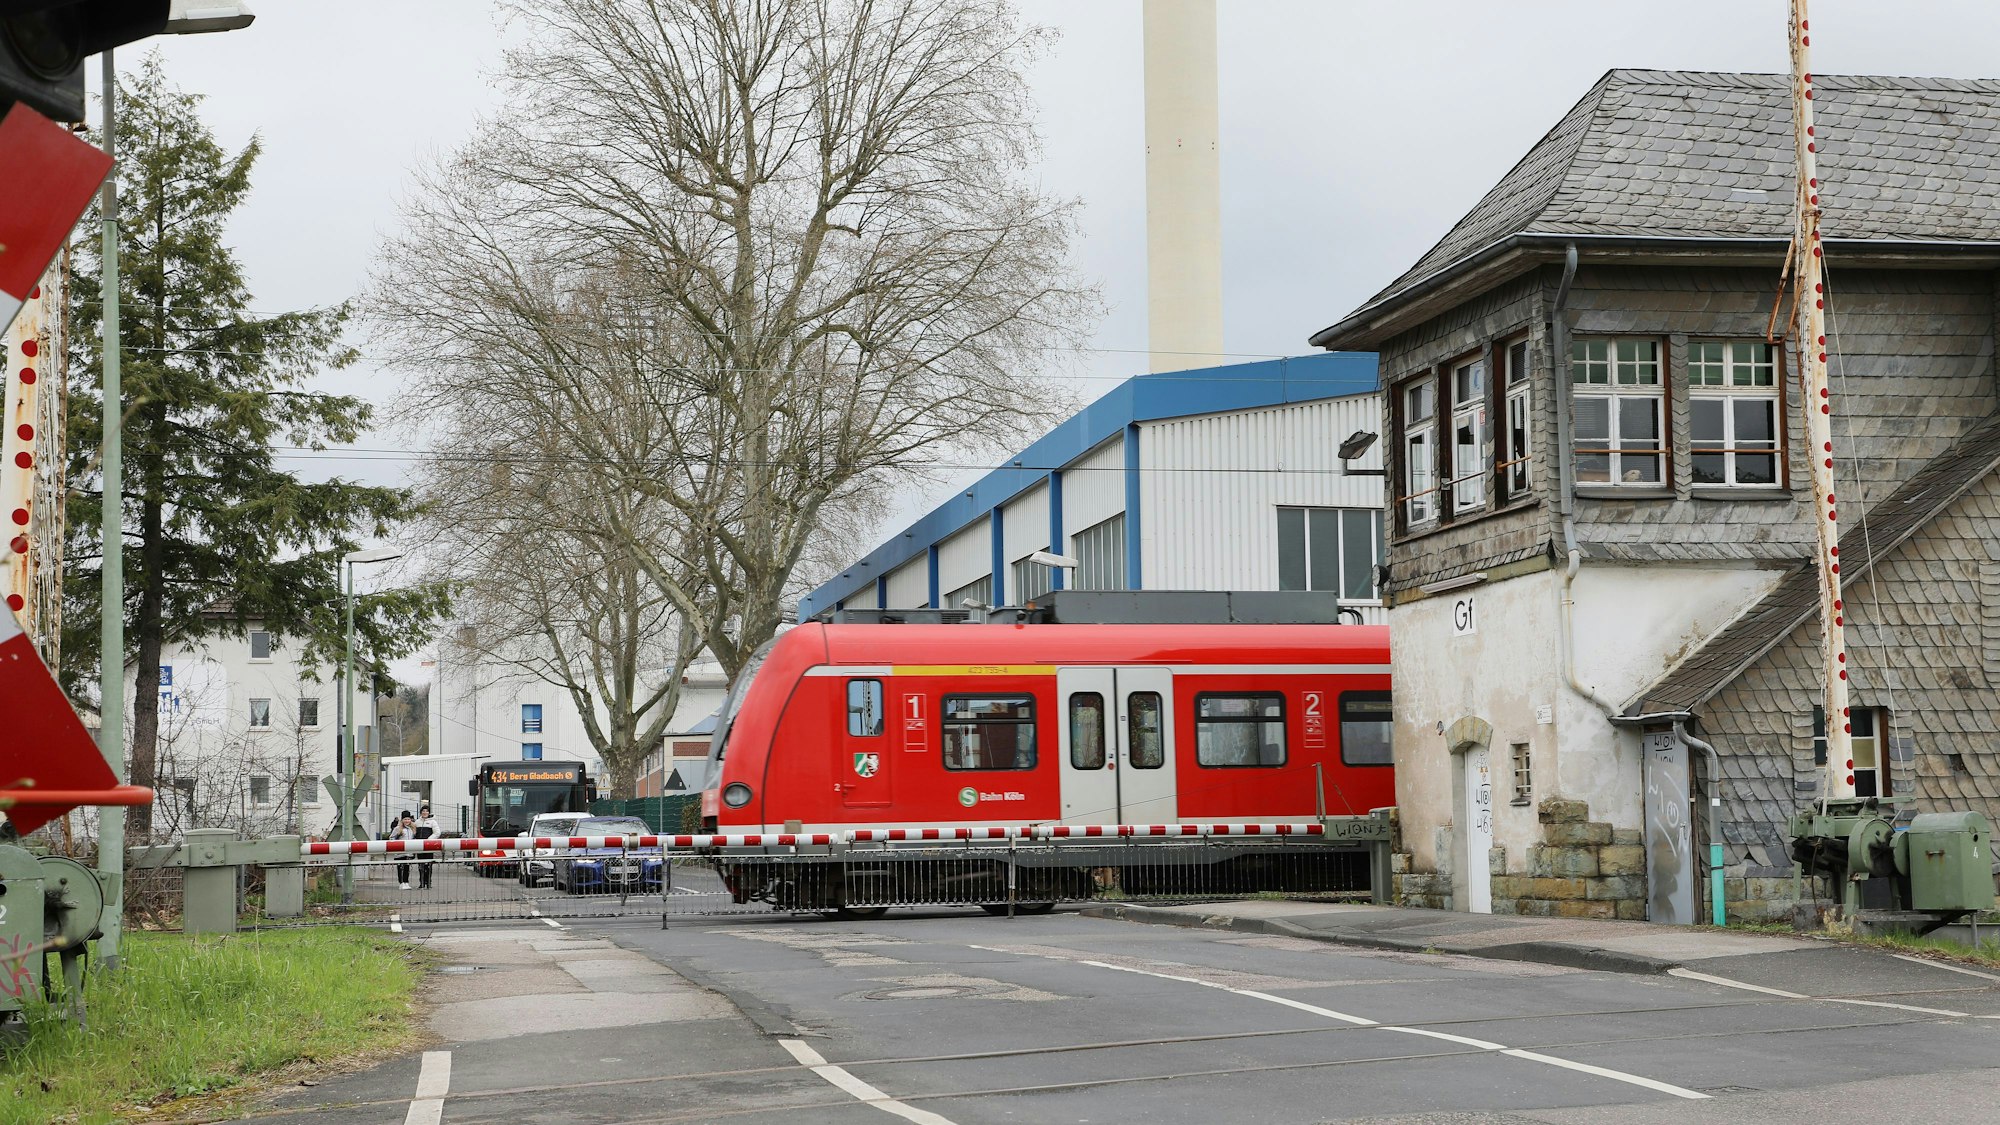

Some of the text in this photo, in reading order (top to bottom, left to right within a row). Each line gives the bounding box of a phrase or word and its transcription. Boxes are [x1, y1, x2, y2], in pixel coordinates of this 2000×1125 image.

[1455, 598, 1473, 631] Gf
[908, 696, 919, 718] 1
[1306, 694, 1320, 715] 2
[491, 771, 507, 783] 434
[509, 772, 528, 780] Berg
[834, 783, 841, 792] 2
[961, 788, 1025, 805] S Bahn Köln
[1973, 846, 1979, 858] 4
